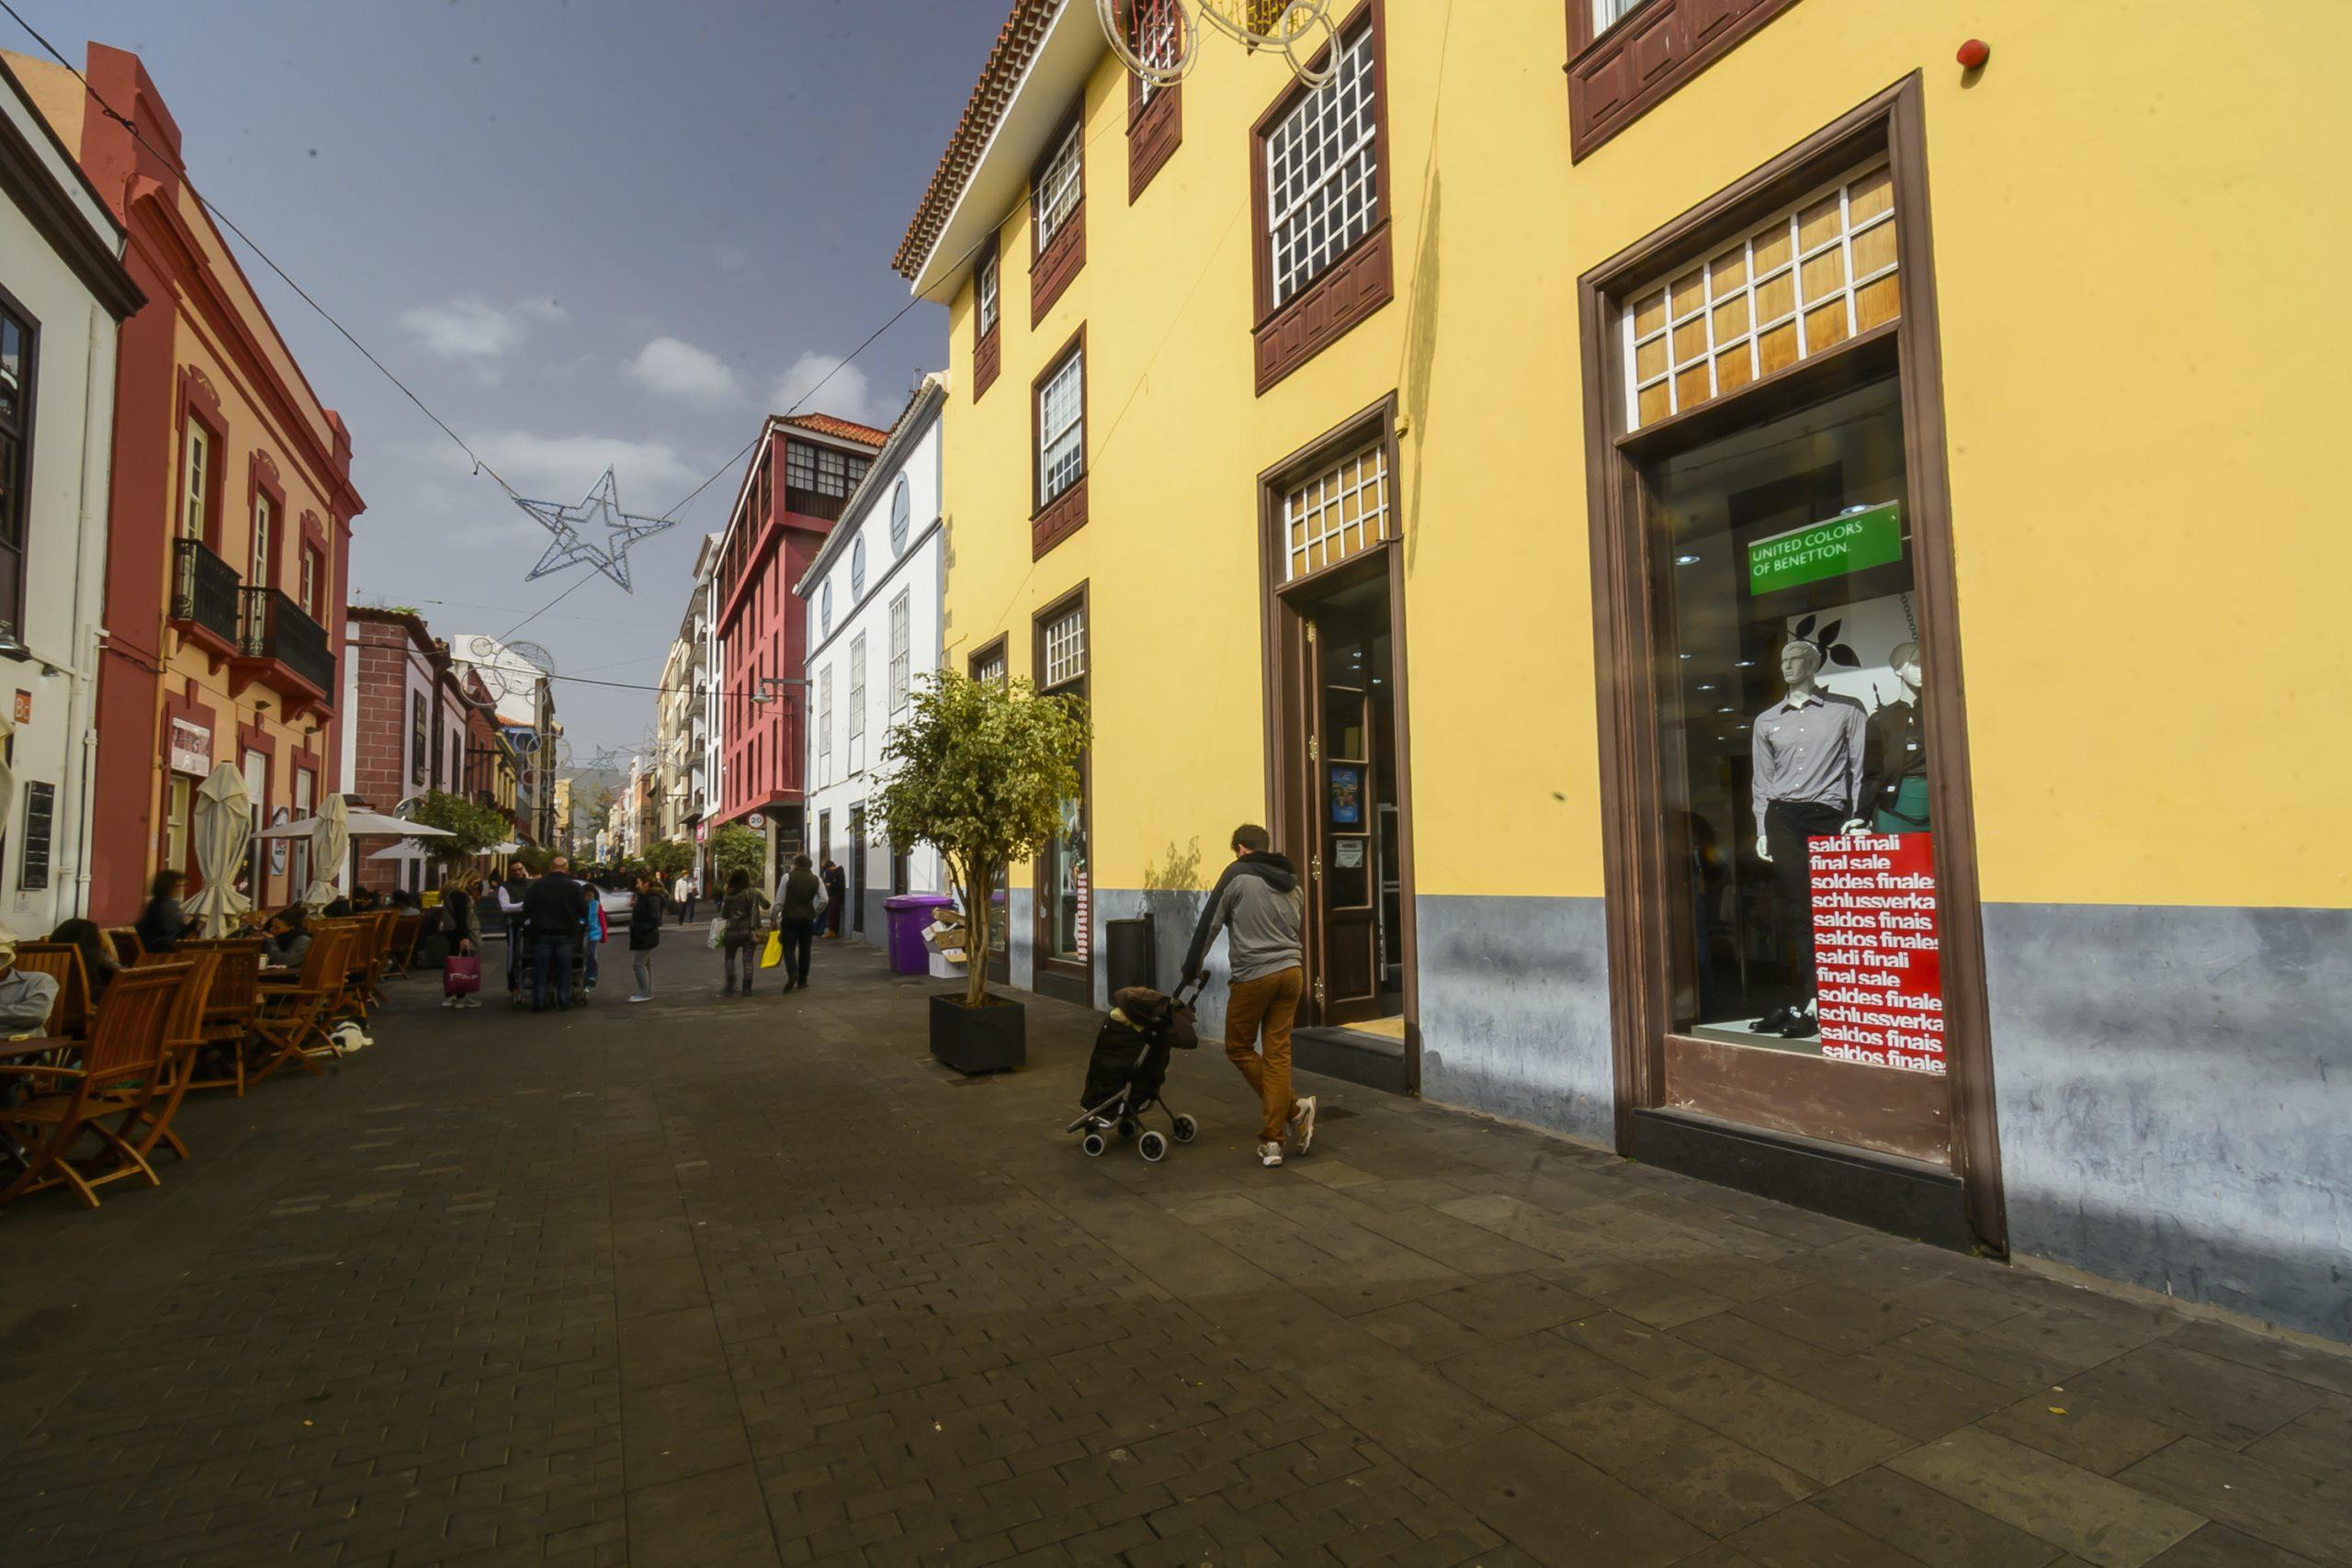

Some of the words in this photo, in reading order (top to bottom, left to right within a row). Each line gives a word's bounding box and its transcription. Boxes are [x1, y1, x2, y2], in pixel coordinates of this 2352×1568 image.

[1752, 538, 1802, 562] UNITED
[1804, 521, 1863, 547] COLORS
[1753, 561, 1770, 576] OF
[1773, 541, 1851, 571] BENETTON.
[1808, 836, 1851, 852] saldi
[1853, 834, 1900, 851] finali
[1810, 854, 1848, 870] final
[1849, 853, 1892, 869] sale
[1811, 873, 1875, 889] soldes
[1811, 892, 1936, 909] schlussverka
[1813, 911, 1876, 928] saldos
[1878, 911, 1933, 930] finais
[1815, 930, 1878, 947] saldos
[1815, 949, 1860, 965] saldi
[1861, 950, 1910, 968] finali
[1816, 966, 1856, 984] final
[1858, 970, 1901, 987] sale
[1817, 987, 1883, 1006] soldes
[1885, 990, 1943, 1011] finale
[1818, 1005, 1944, 1032] schlussverka
[1820, 1024, 1883, 1045] saldos
[1885, 1030, 1943, 1053] finais
[1821, 1043, 1884, 1065] saldos
[1886, 1050, 1947, 1074] finale
